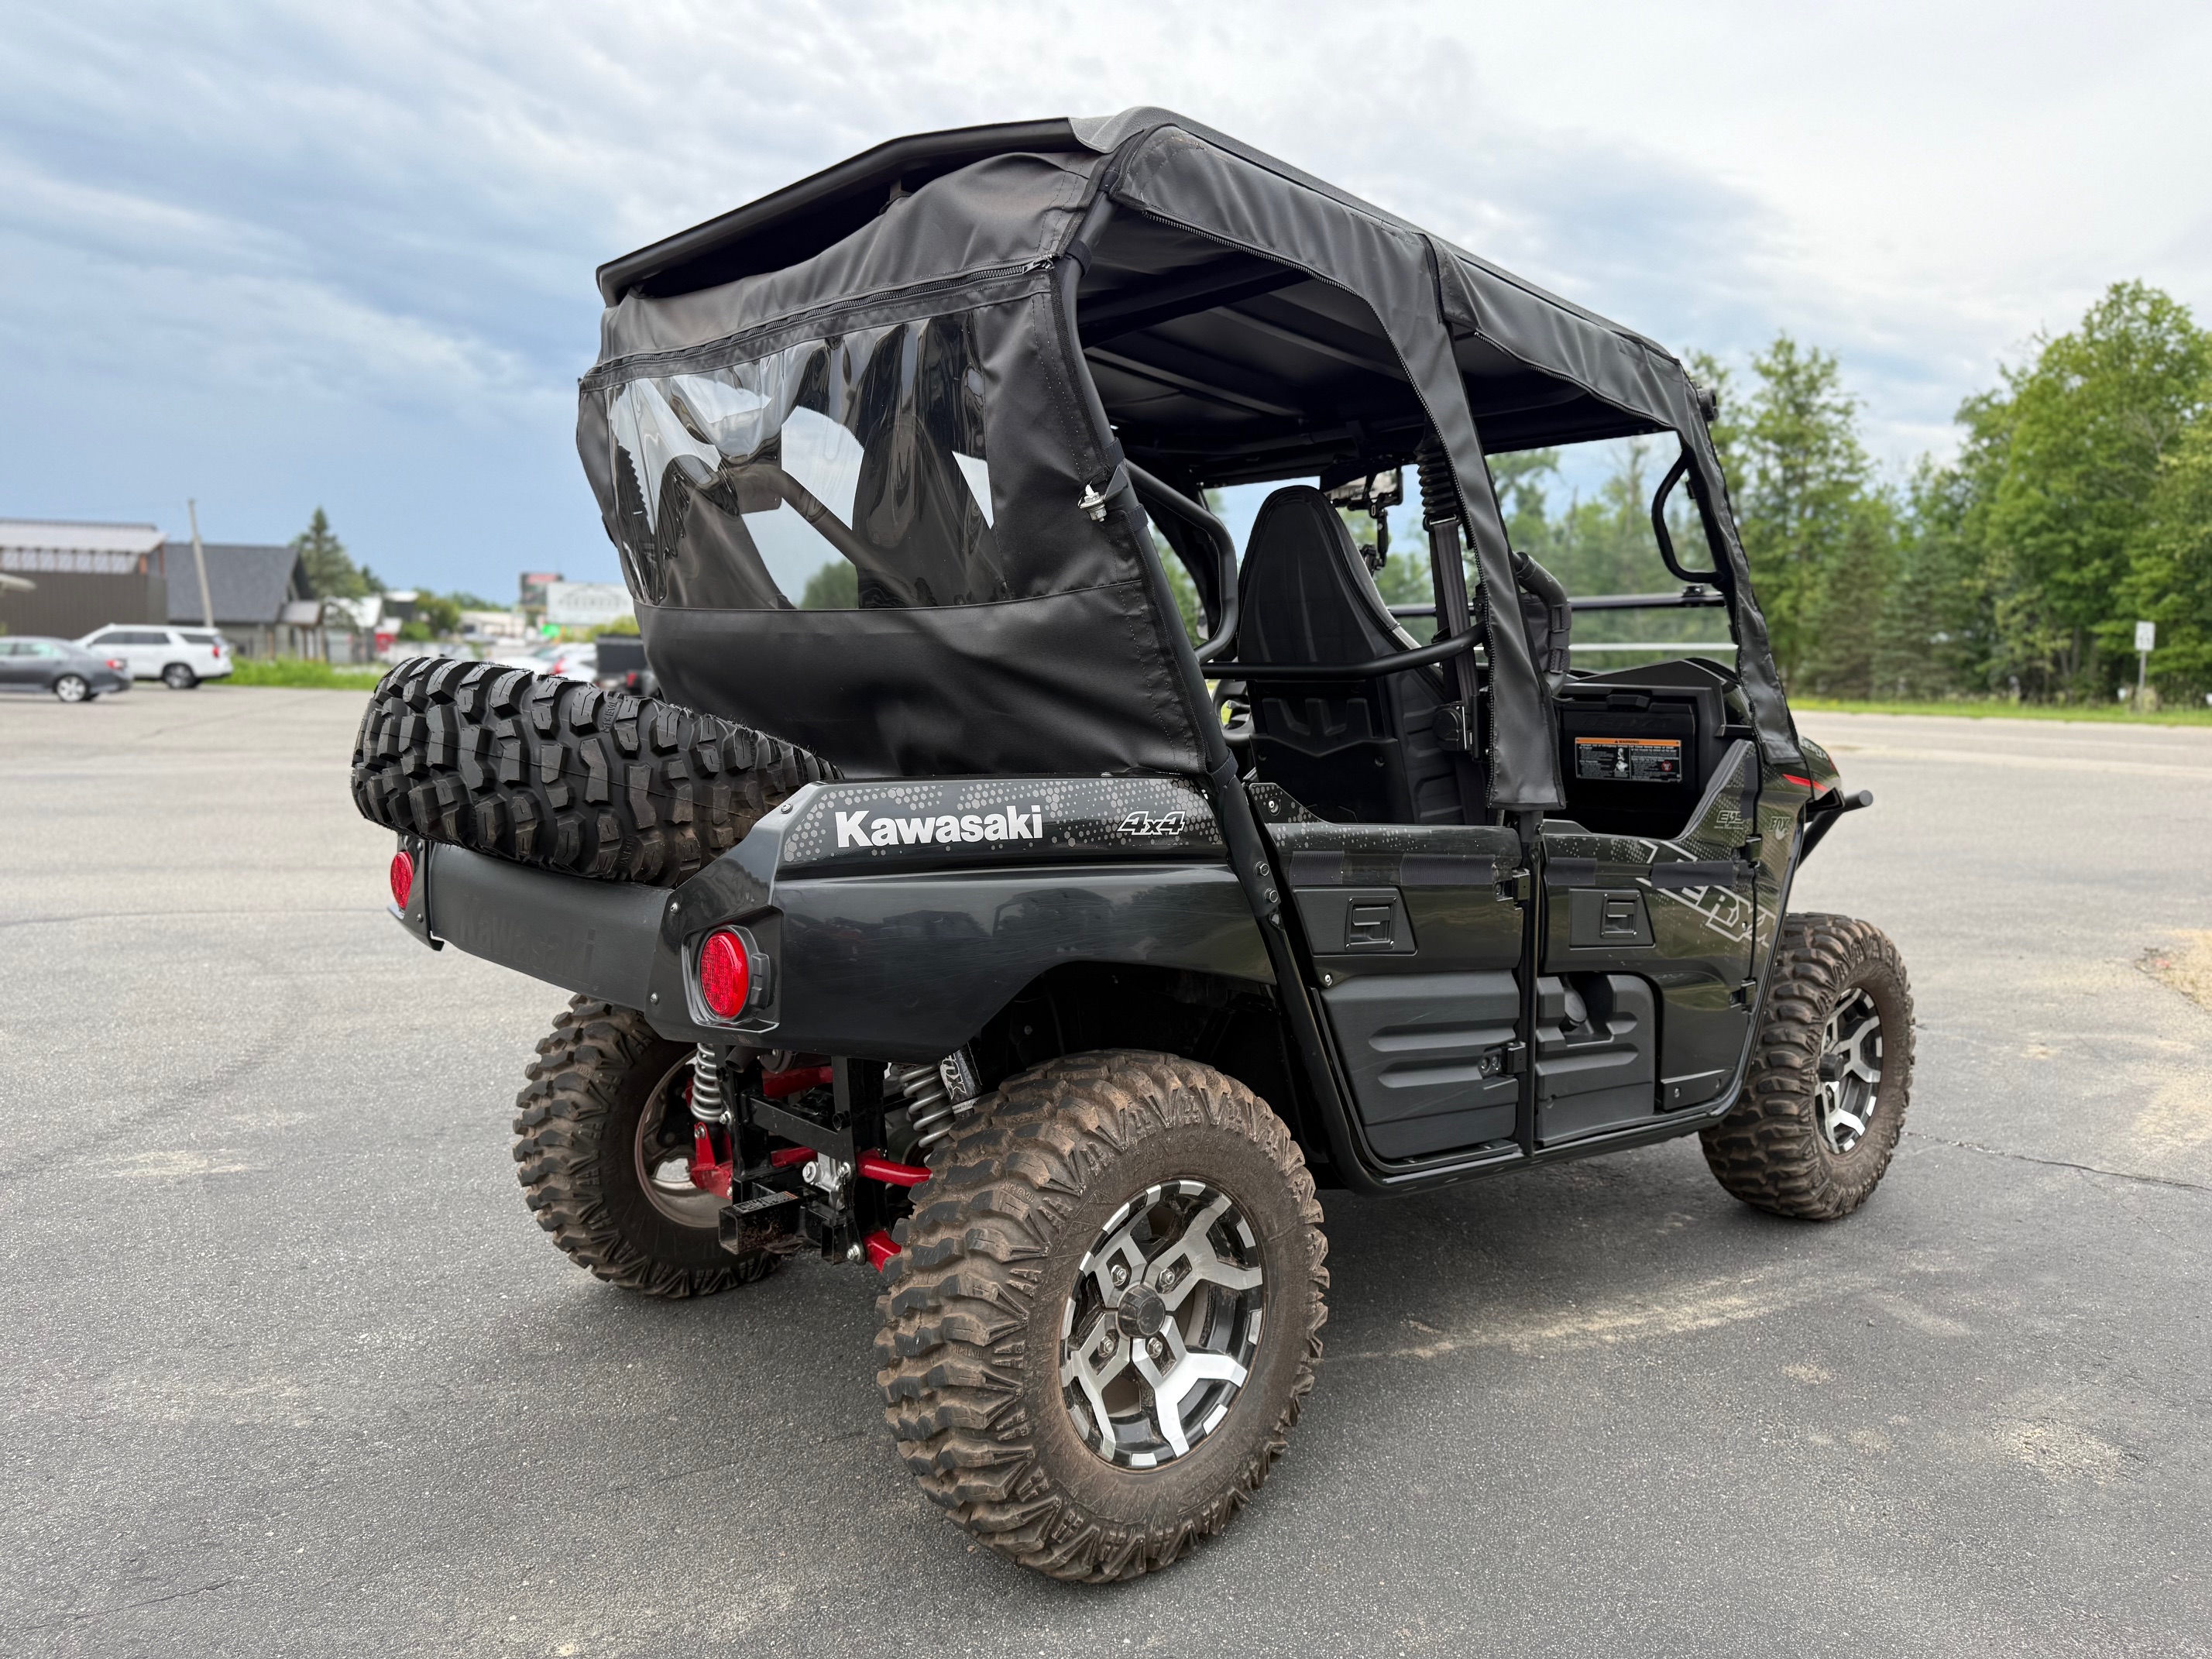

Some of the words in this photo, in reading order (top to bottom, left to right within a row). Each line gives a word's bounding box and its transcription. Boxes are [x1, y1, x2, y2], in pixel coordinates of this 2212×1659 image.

[835, 805, 1042, 848] Kawasaki
[1117, 811, 1186, 836] 4x4
[1768, 816, 1791, 837] FOX
[459, 893, 596, 986] Kawasaki
